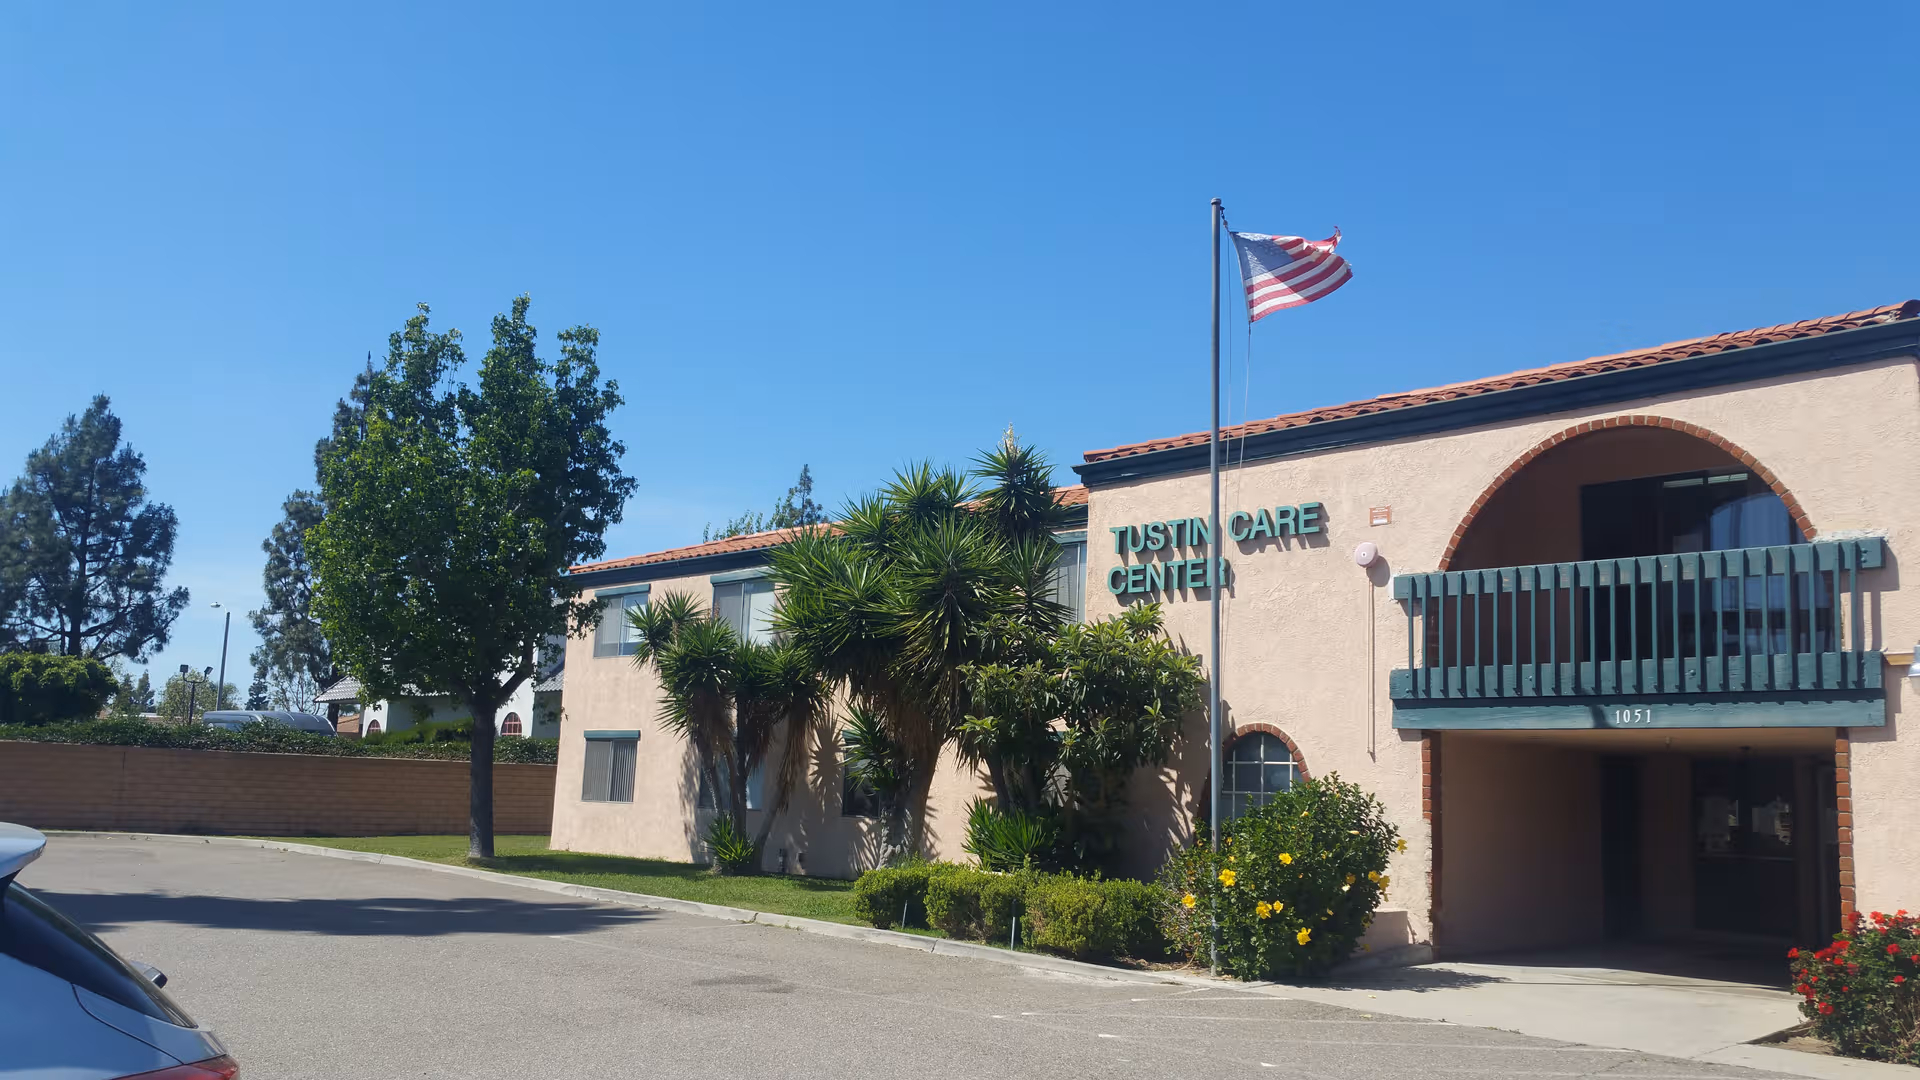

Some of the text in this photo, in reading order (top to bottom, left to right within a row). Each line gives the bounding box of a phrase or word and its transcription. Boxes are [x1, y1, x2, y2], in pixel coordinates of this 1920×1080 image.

[1110, 502, 1320, 554] TUSTIN CARE
[1615, 709, 1651, 724] 1051
